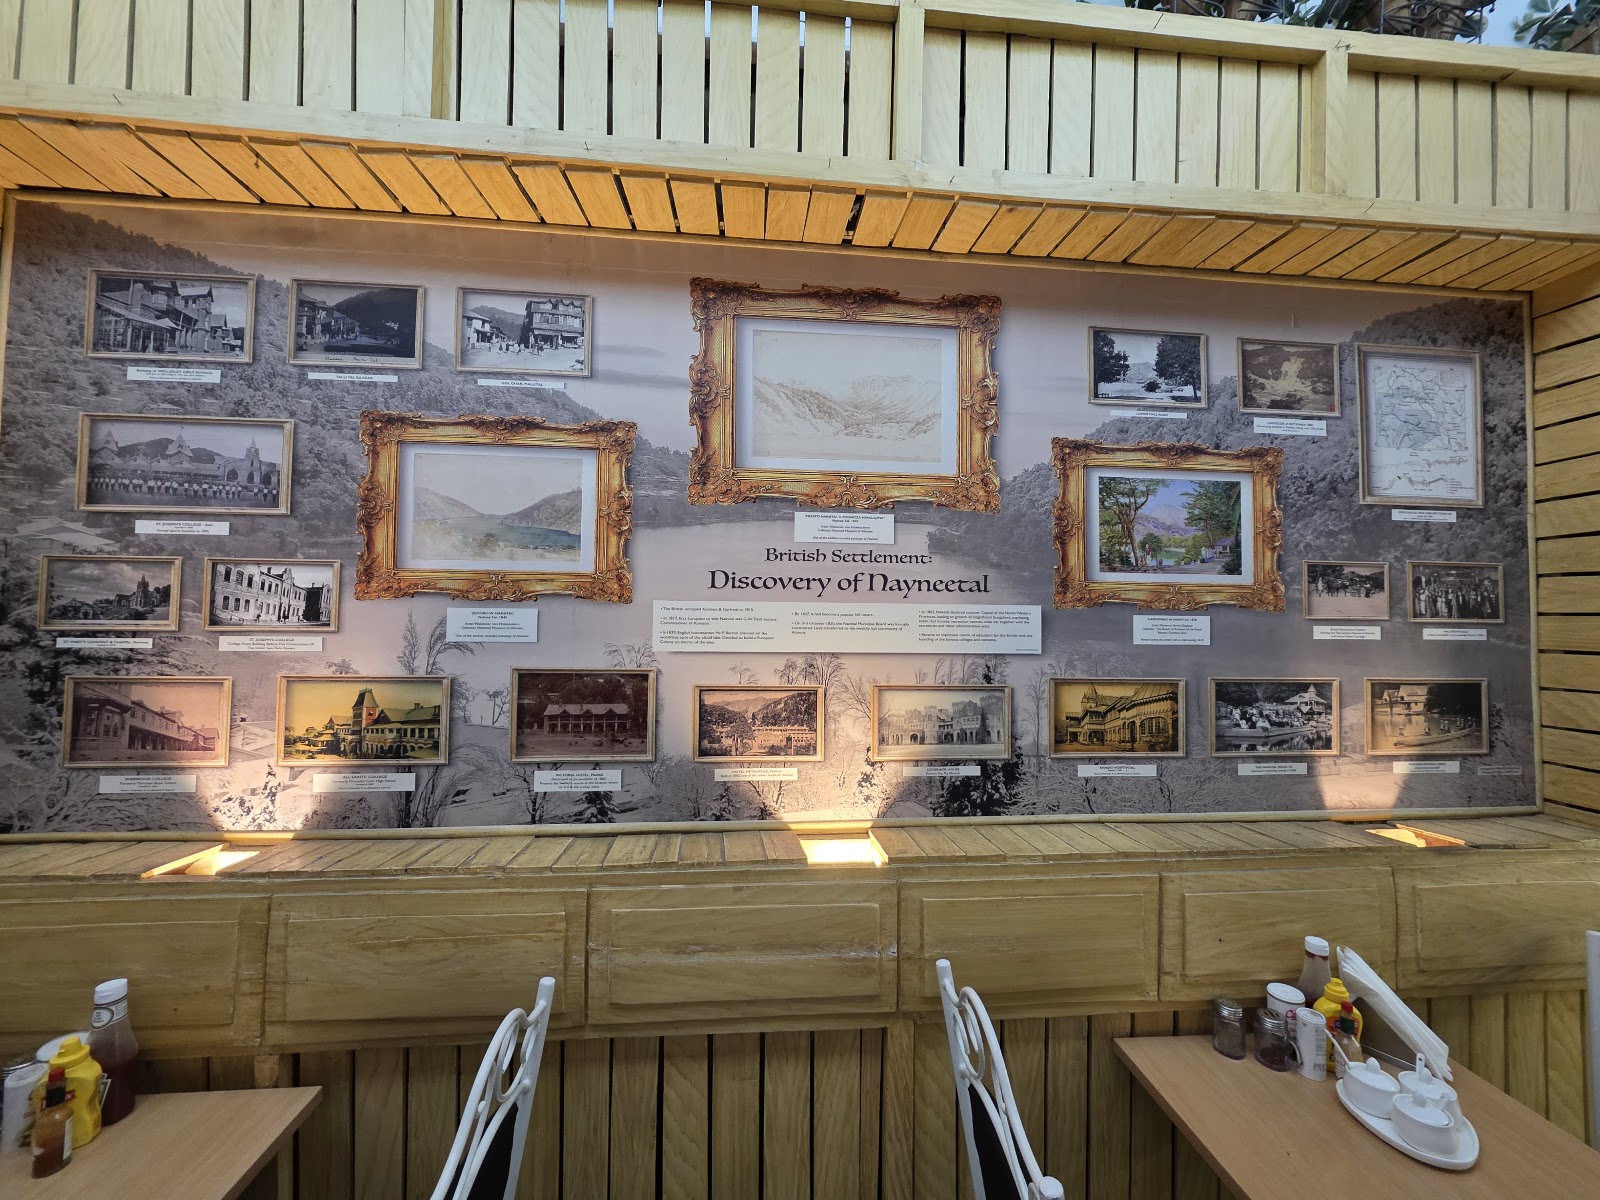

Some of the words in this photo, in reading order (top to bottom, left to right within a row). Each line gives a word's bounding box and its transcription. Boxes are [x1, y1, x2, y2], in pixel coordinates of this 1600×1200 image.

[764, 548, 826, 563] British
[832, 549, 932, 564] Settlement:
[708, 569, 832, 598] Discovery
[837, 572, 865, 594] of
[868, 573, 990, 598] Nayneetal
